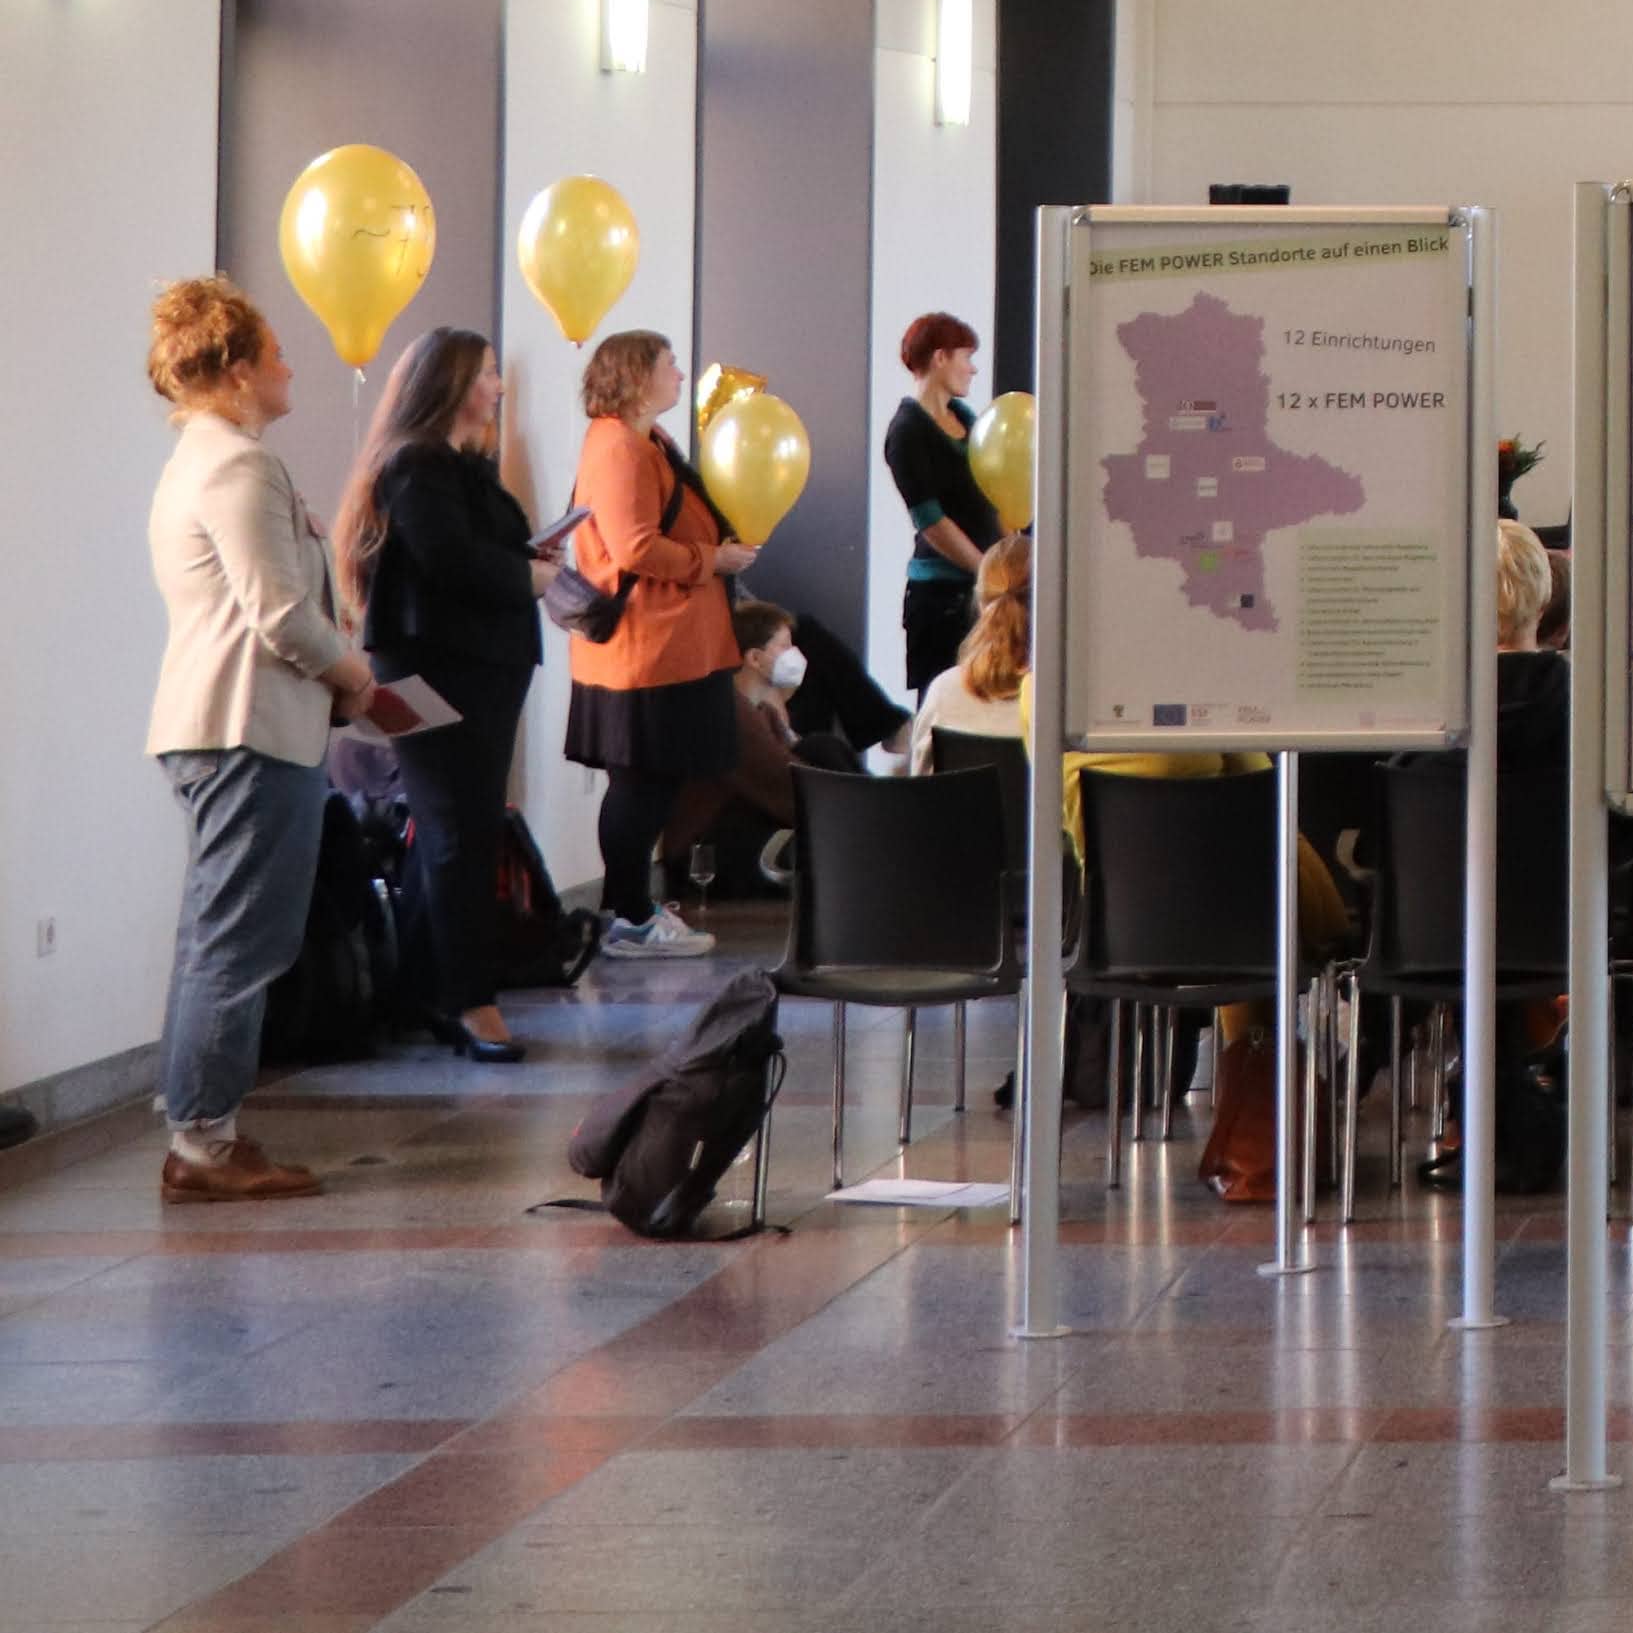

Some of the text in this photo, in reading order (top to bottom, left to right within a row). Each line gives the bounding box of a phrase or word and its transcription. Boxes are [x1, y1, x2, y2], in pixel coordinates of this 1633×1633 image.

[1119, 258, 1155, 273] FEM
[1160, 252, 1224, 271] POWER
[1229, 245, 1316, 266] Standorte
[1321, 243, 1349, 260] auf
[1353, 240, 1402, 258] einen
[1407, 236, 1449, 254] Blick
[1284, 331, 1436, 355] 12 Einrichtungen
[1277, 392, 1446, 409] 12 x FEM POWER
